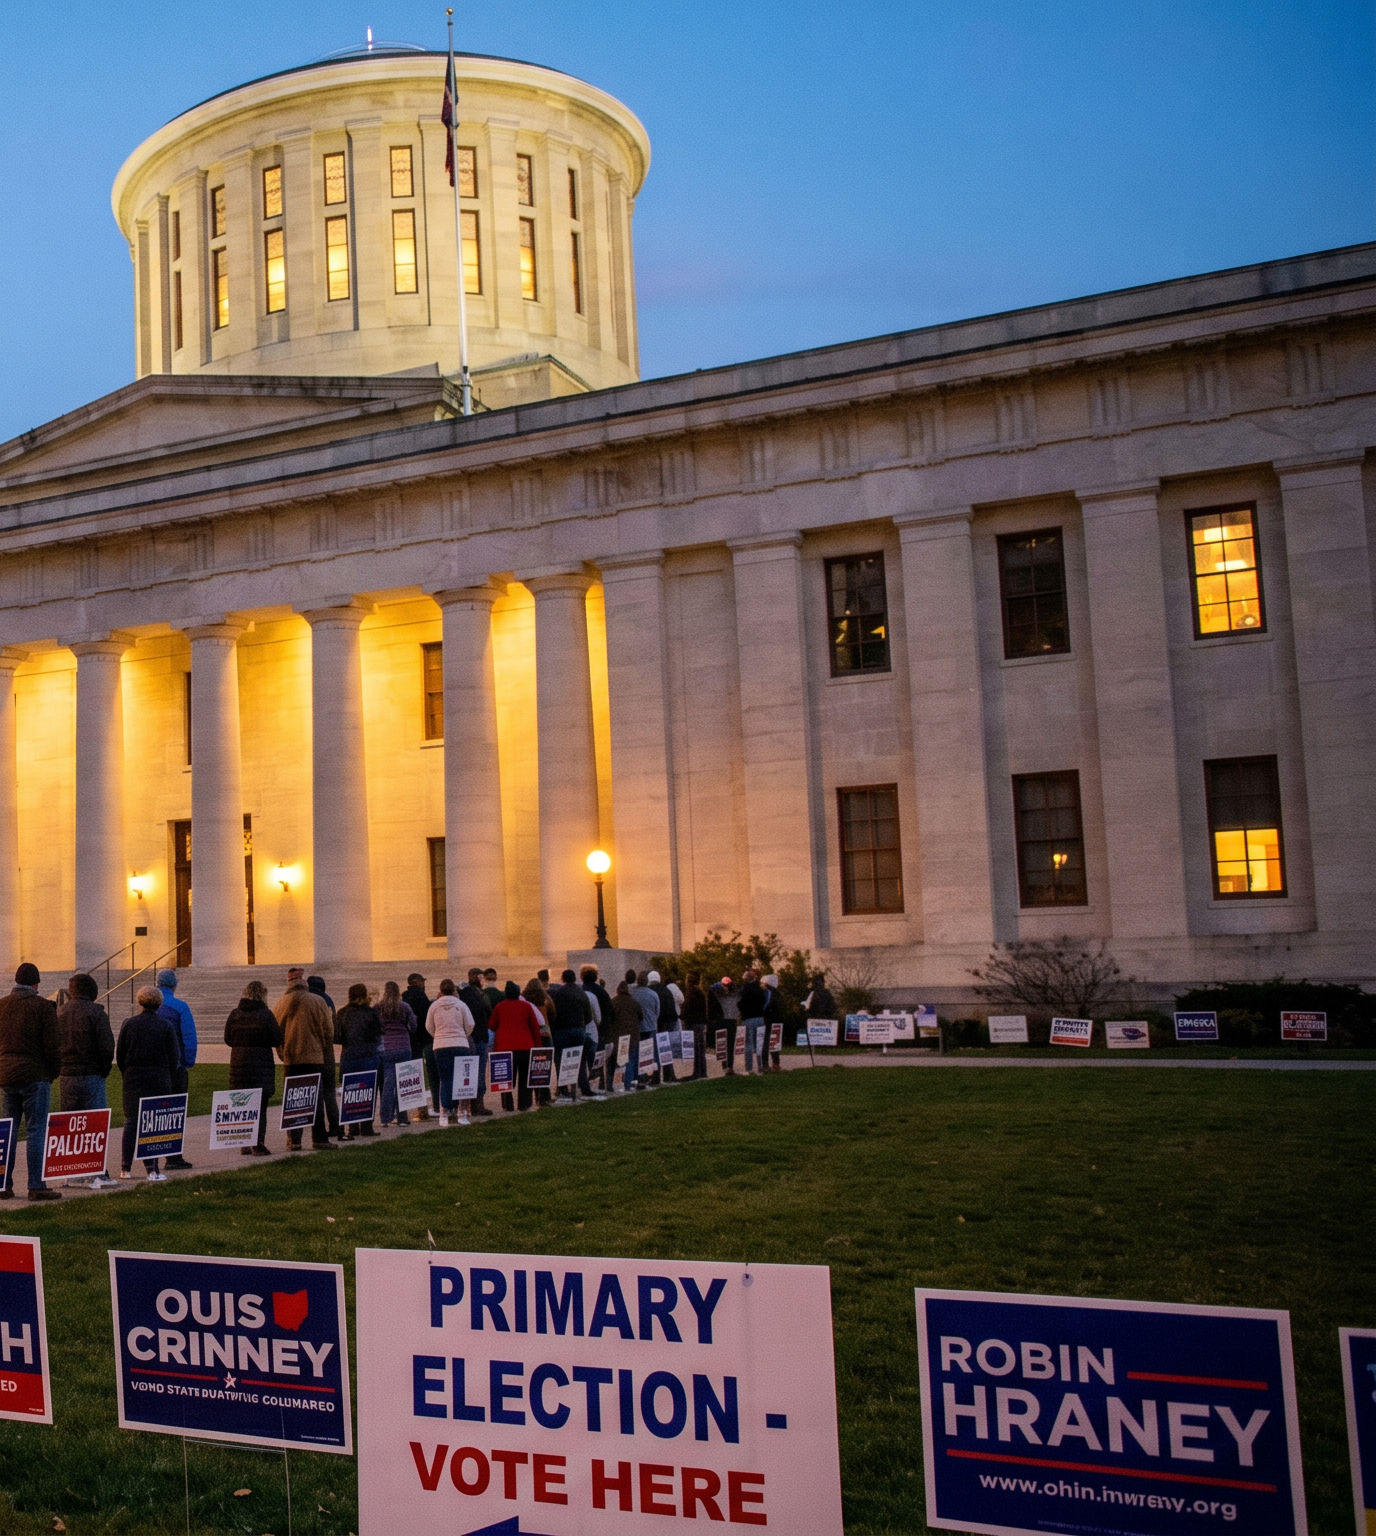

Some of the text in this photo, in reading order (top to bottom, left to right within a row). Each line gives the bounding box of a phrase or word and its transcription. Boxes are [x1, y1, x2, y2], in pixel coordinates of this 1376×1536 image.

[155, 1288, 267, 1327] OUIS
[428, 1264, 728, 1345] PRIMARY
[126, 1326, 334, 1379] CRINNEY
[940, 1335, 1116, 1385] ROBIN
[412, 1353, 740, 1444] ELECTION
[942, 1382, 1272, 1467] HRANEY
[409, 1441, 768, 1526] VOTE HERE
